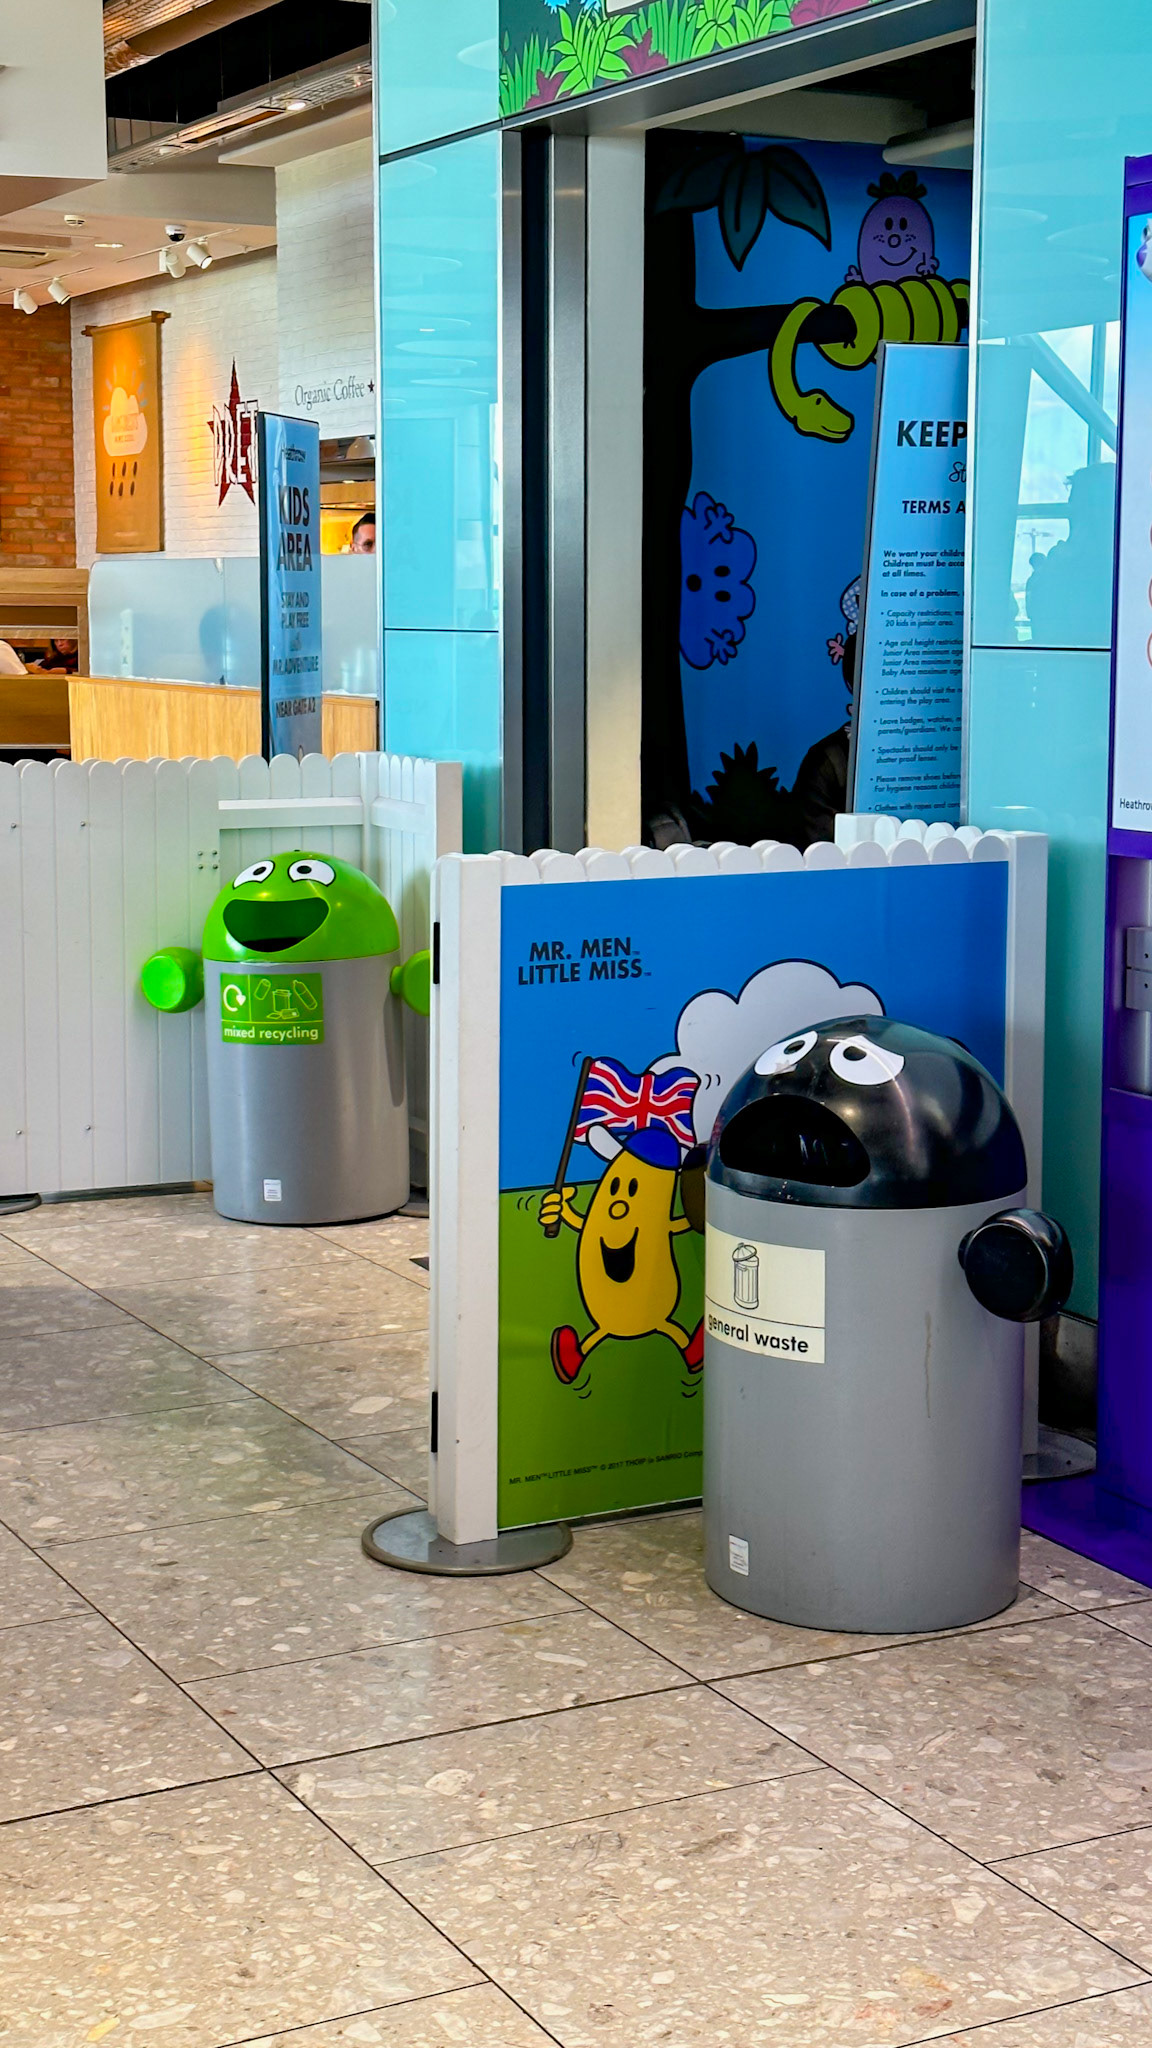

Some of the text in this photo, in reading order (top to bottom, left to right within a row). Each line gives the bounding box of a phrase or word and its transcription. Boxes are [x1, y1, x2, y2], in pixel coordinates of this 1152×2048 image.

[295, 375, 365, 411] Organic Coffee
[897, 420, 968, 448] KEEP
[213, 399, 258, 486] PRET
[279, 485, 310, 527] KIDS
[902, 500, 951, 514] TERMS
[277, 533, 312, 572] AREA
[920, 551, 939, 559] your
[892, 569, 901, 577] all
[295, 592, 309, 607] AND
[909, 589, 918, 597] of
[926, 589, 960, 598] problem,
[887, 609, 916, 618] Capacity
[884, 640, 898, 648] Age
[900, 638, 913, 646] and
[915, 638, 934, 647] height
[882, 669, 898, 677] Baby
[276, 700, 292, 718] NEAR
[1120, 797, 1152, 811] Heathro
[529, 941, 572, 962] MR.
[518, 963, 581, 985] LITTLE
[224, 1025, 319, 1041] mixed recycling
[708, 1314, 809, 1353] general waste
[548, 1469, 572, 1479] LITTLE
